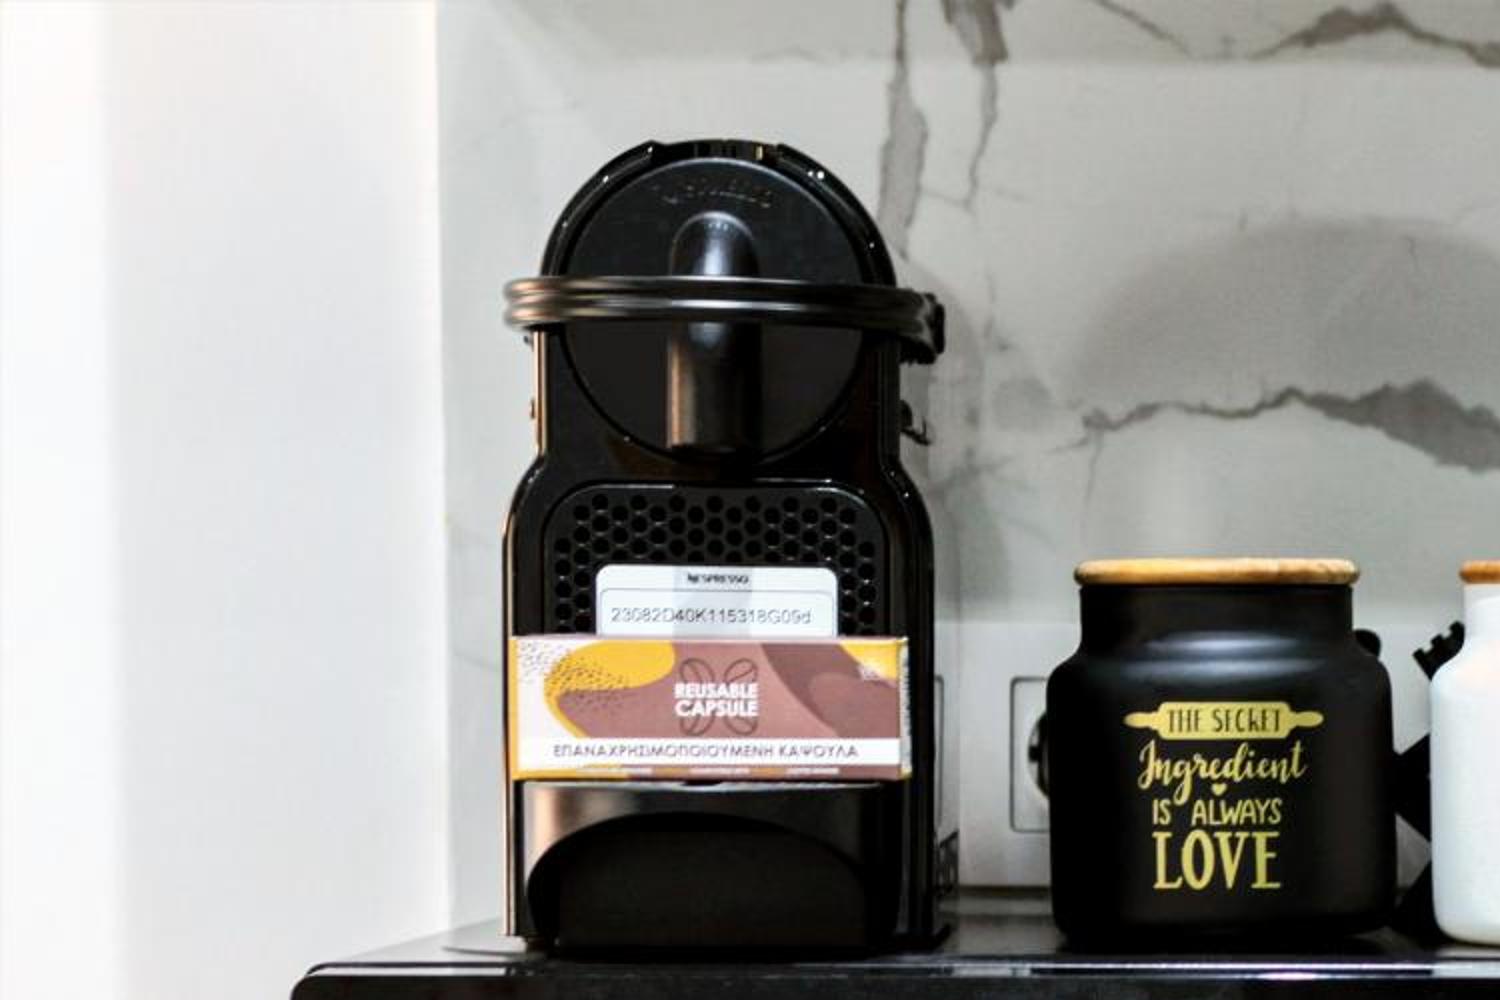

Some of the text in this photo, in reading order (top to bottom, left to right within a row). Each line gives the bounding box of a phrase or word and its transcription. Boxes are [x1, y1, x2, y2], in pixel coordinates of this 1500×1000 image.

[674, 682, 759, 699] REUSABLE
[674, 699, 759, 717] CAPSULE
[1168, 708, 1281, 733] THE SECRET
[778, 743, 859, 758] ΚΑΨΟΥΛΑ
[1137, 739, 1308, 807] Ingredient
[1152, 797, 1283, 826] IS ALWAYS
[1152, 829, 1282, 890] LOVE
